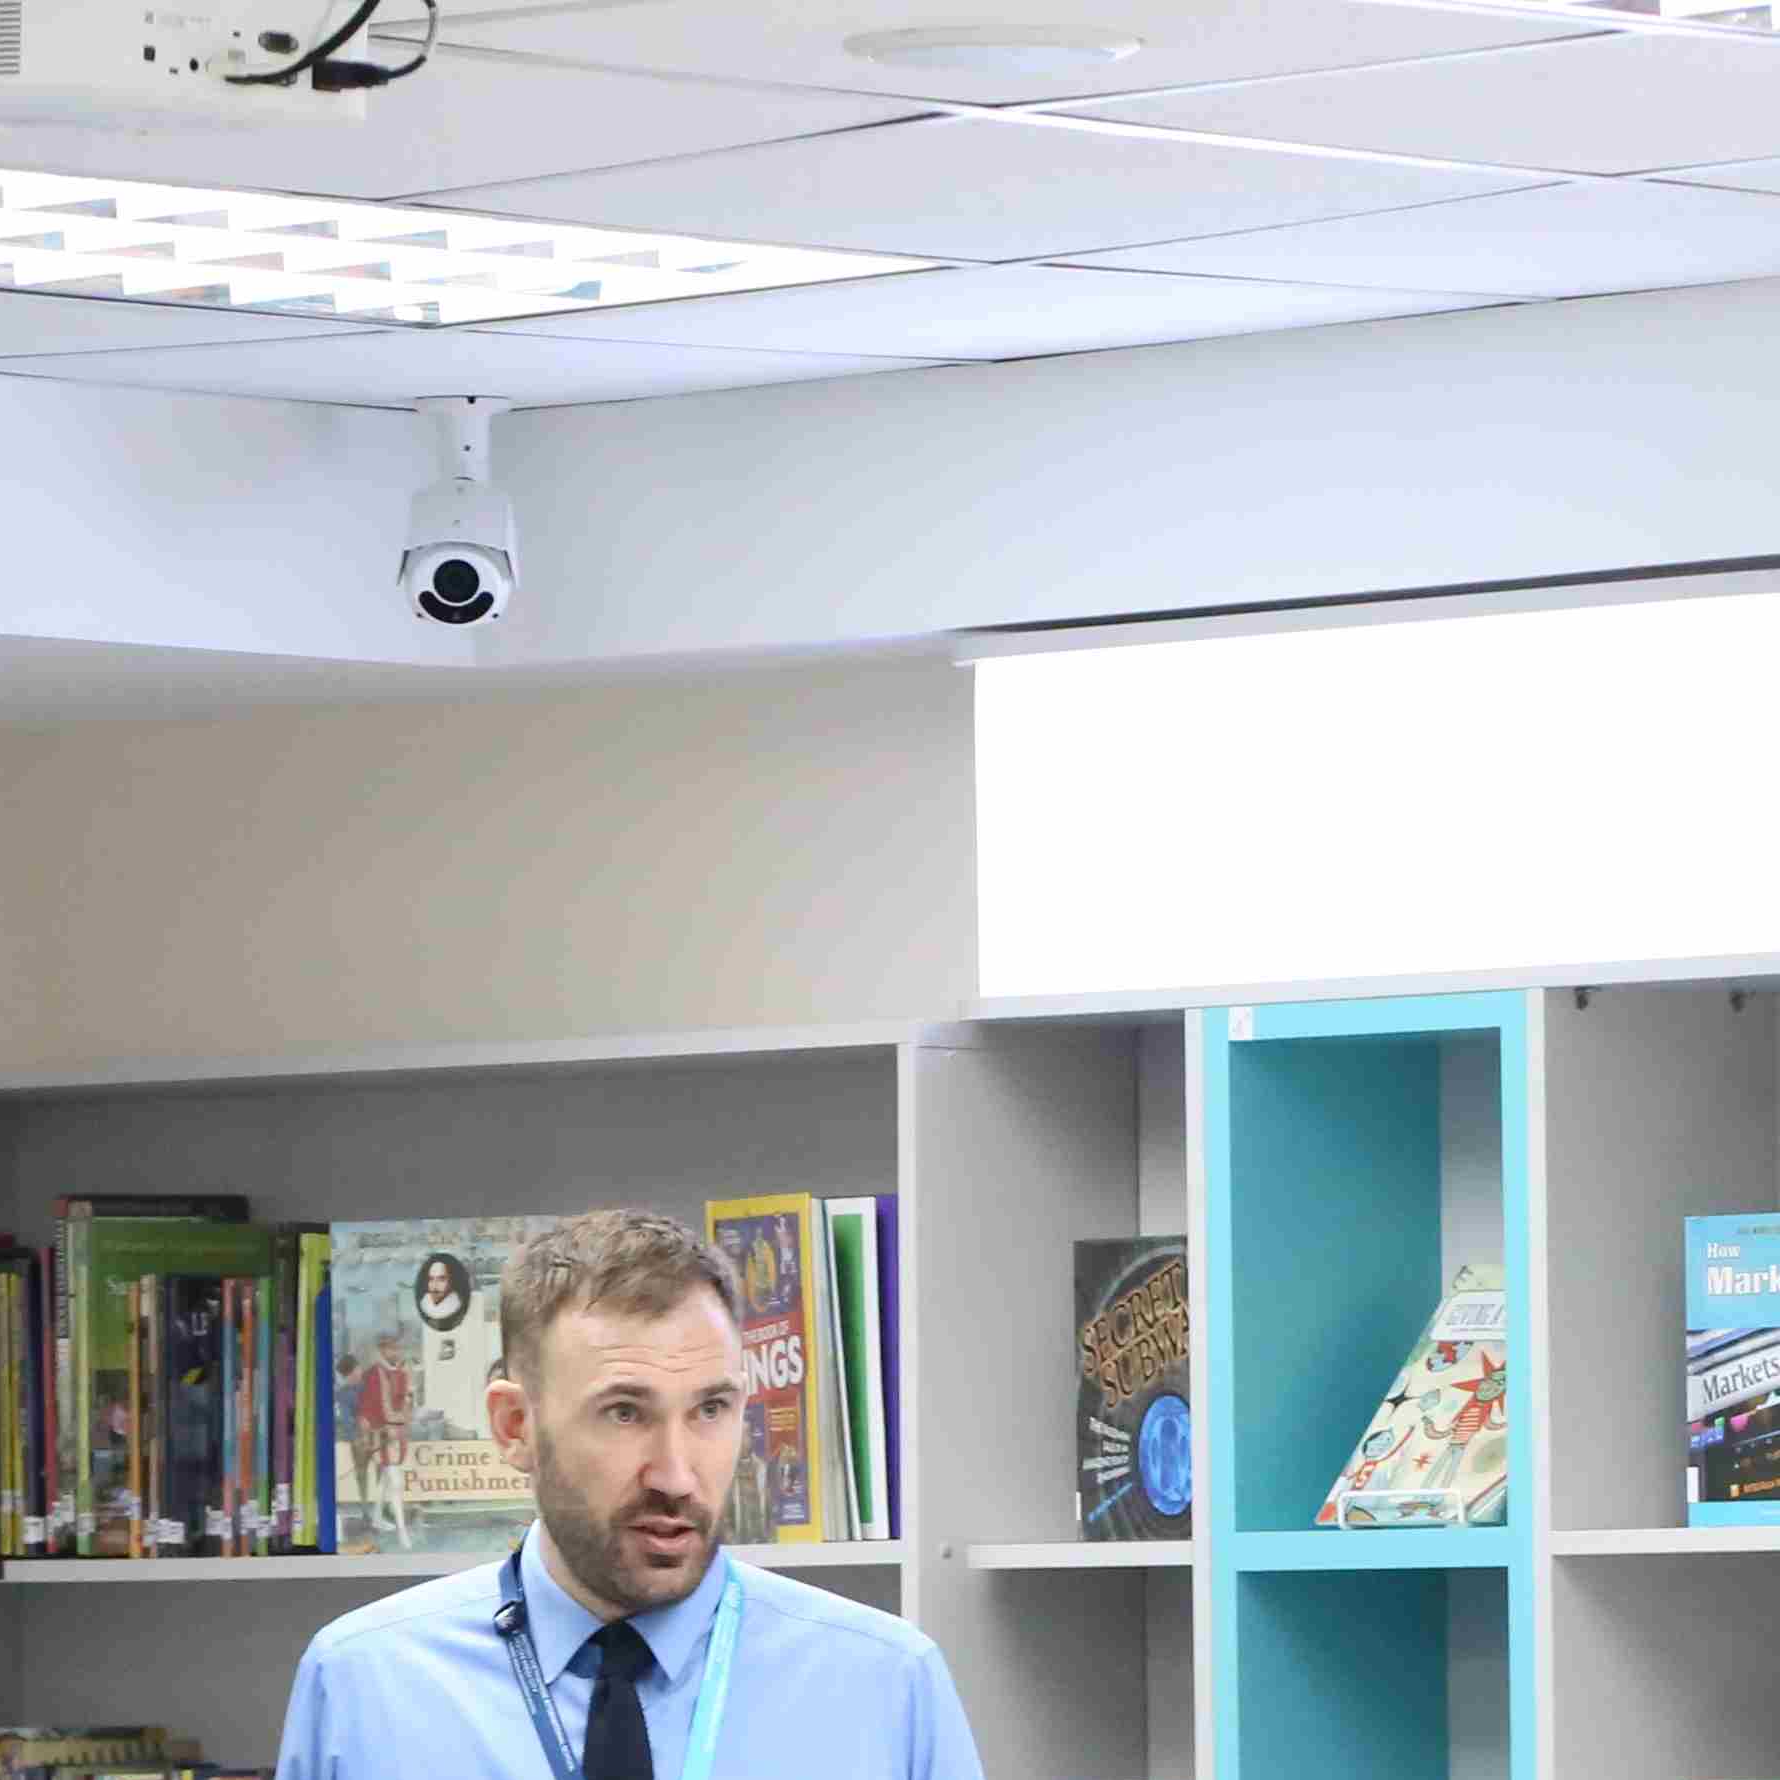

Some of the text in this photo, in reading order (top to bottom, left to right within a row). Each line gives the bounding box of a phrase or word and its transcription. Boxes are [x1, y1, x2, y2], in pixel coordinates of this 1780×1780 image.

[1707, 1242, 1741, 1258] How
[1083, 1260, 1180, 1376] SECRET
[1703, 1357, 1780, 1404] Markets
[415, 1444, 490, 1466] Crime
[403, 1468, 532, 1492] Punishme
